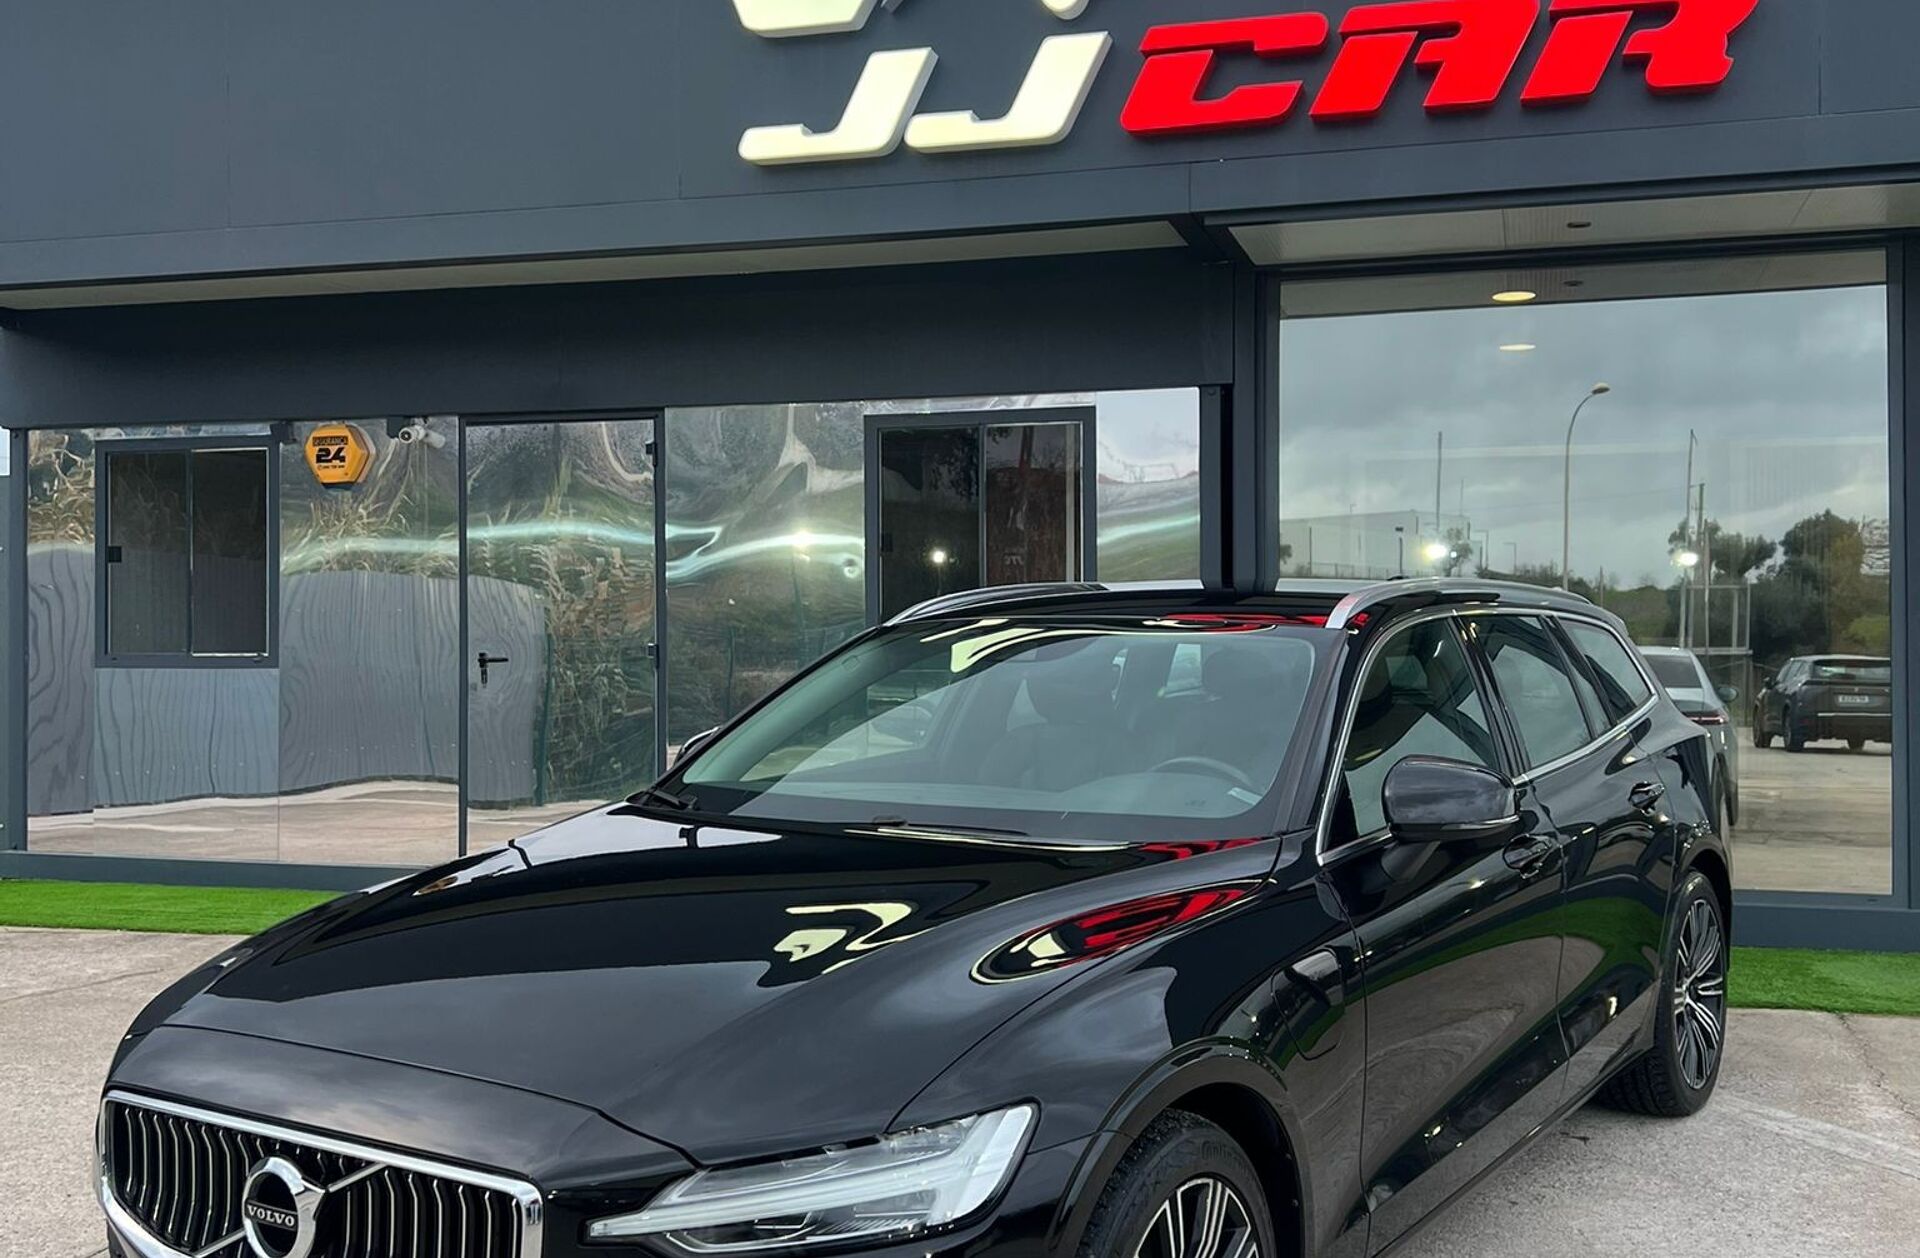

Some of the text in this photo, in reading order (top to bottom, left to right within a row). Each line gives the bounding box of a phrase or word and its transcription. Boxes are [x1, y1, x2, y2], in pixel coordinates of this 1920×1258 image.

[738, 0, 1759, 165] JJ CAR
[316, 447, 346, 463] 24
[246, 1204, 295, 1227] VOLVO
